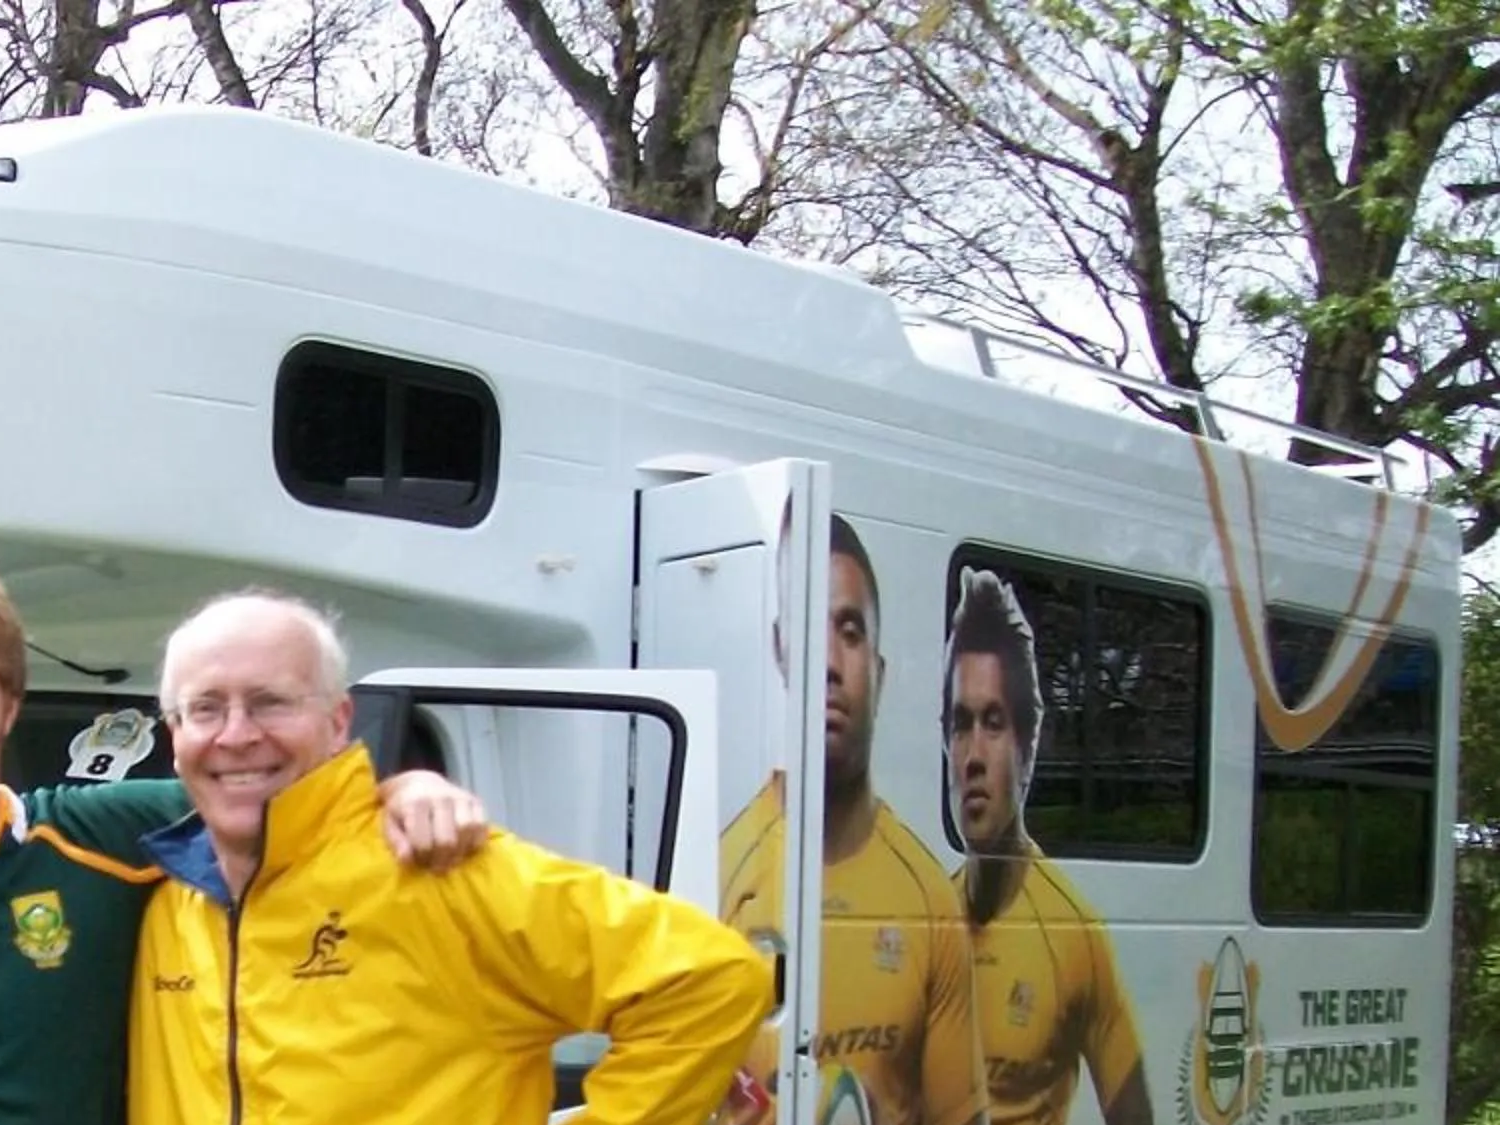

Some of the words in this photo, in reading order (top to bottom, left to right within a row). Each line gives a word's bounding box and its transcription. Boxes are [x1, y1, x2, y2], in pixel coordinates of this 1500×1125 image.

[86, 753, 115, 775] 8
[1299, 989, 1341, 1028] THE
[1345, 987, 1408, 1026] GREAT
